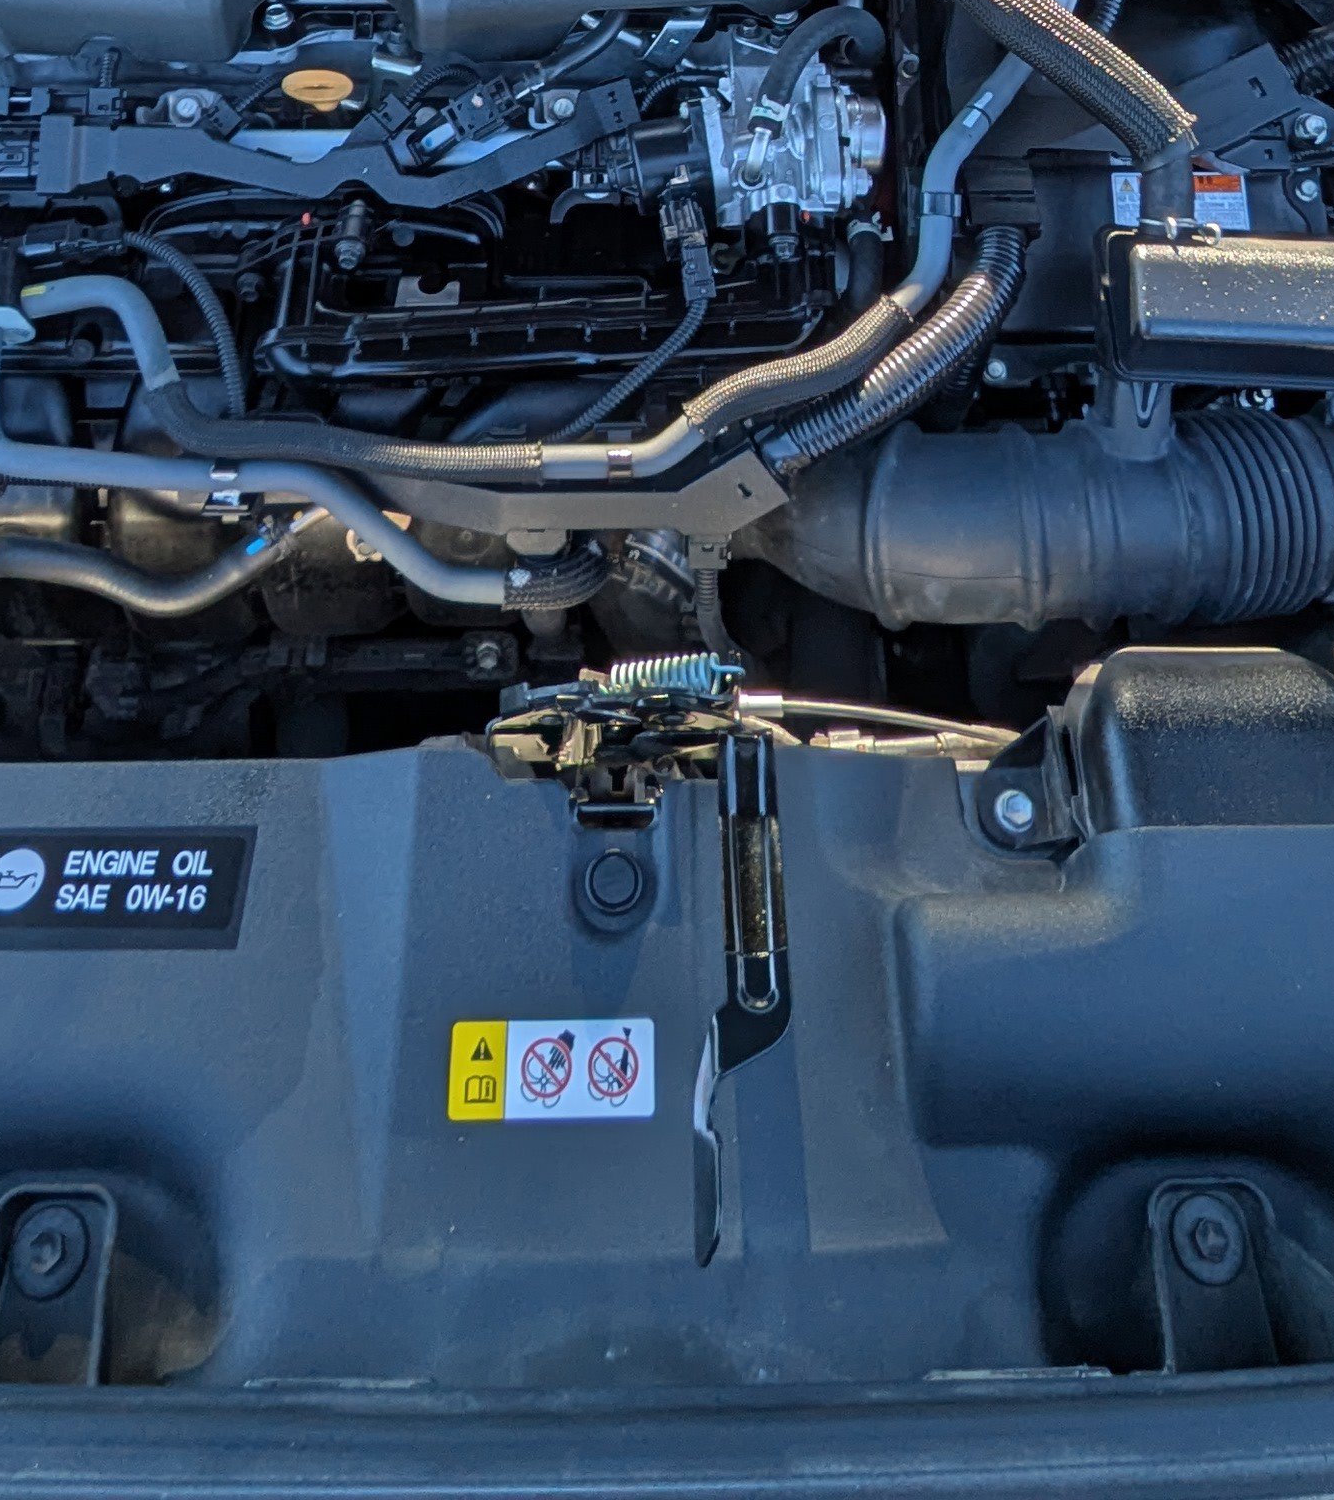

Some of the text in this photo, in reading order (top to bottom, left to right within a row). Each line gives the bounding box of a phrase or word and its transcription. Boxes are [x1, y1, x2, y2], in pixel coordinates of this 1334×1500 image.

[63, 850, 213, 877] ENGINE OIL
[54, 884, 208, 911] SAE 0W-16
